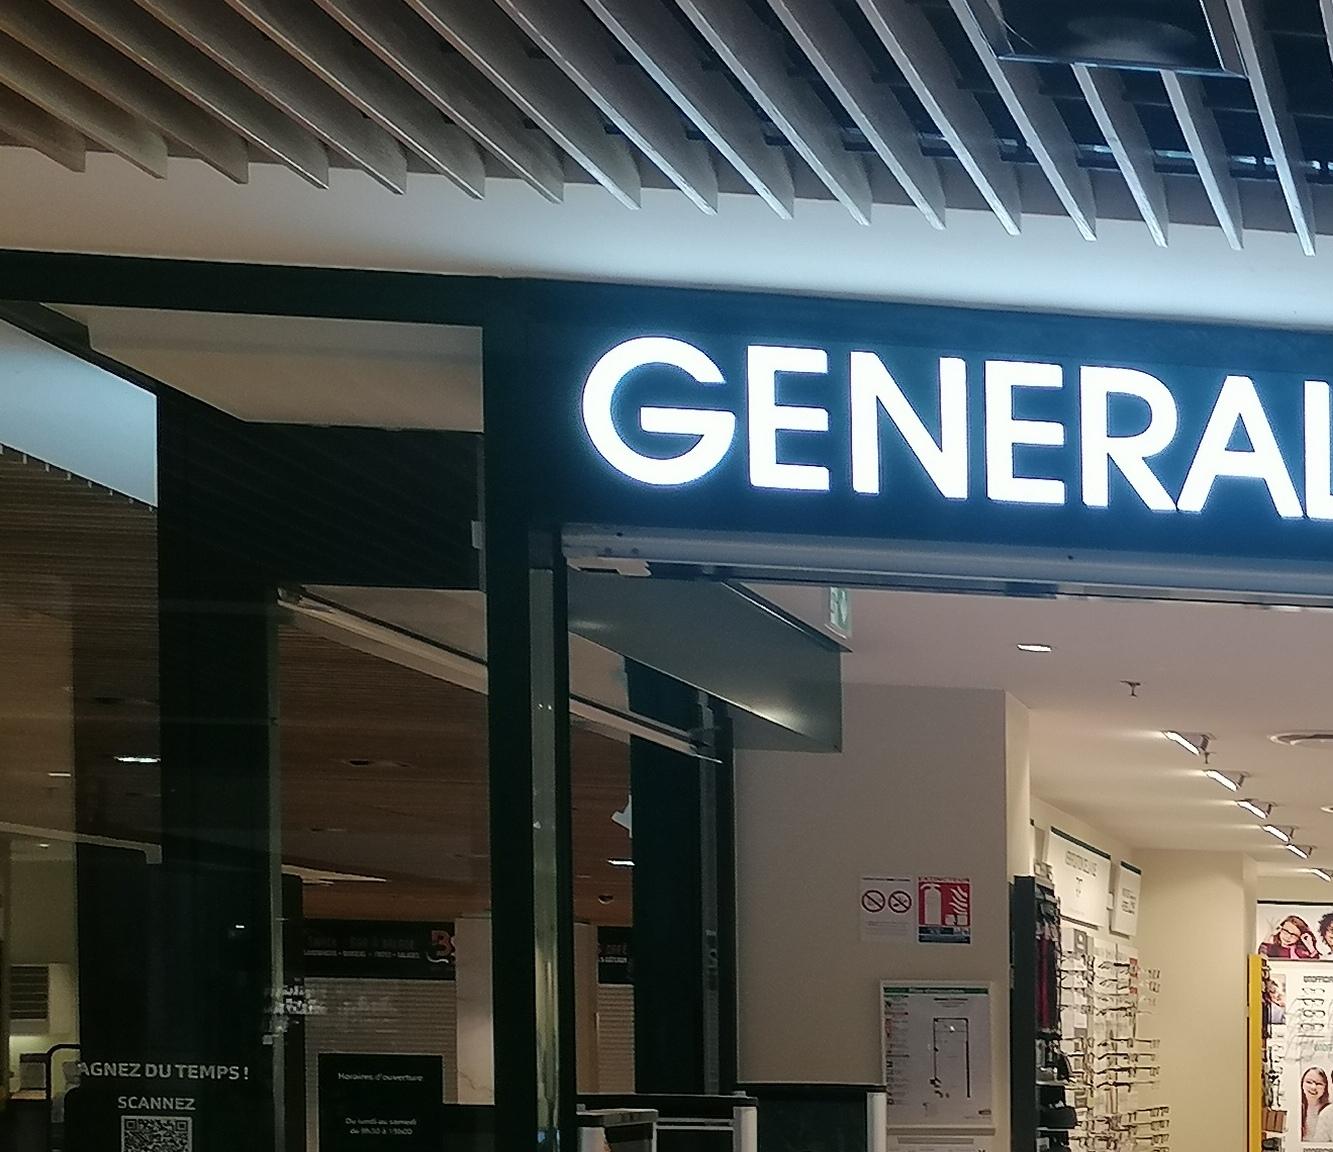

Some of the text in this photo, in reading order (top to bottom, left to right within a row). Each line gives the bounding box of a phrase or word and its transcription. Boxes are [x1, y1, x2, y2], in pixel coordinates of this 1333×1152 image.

[78, 1062, 141, 1077] AGNEZ
[145, 1063, 171, 1078] DU
[175, 1064, 239, 1080] TEMPS
[117, 1096, 196, 1110] SCANNEZ
